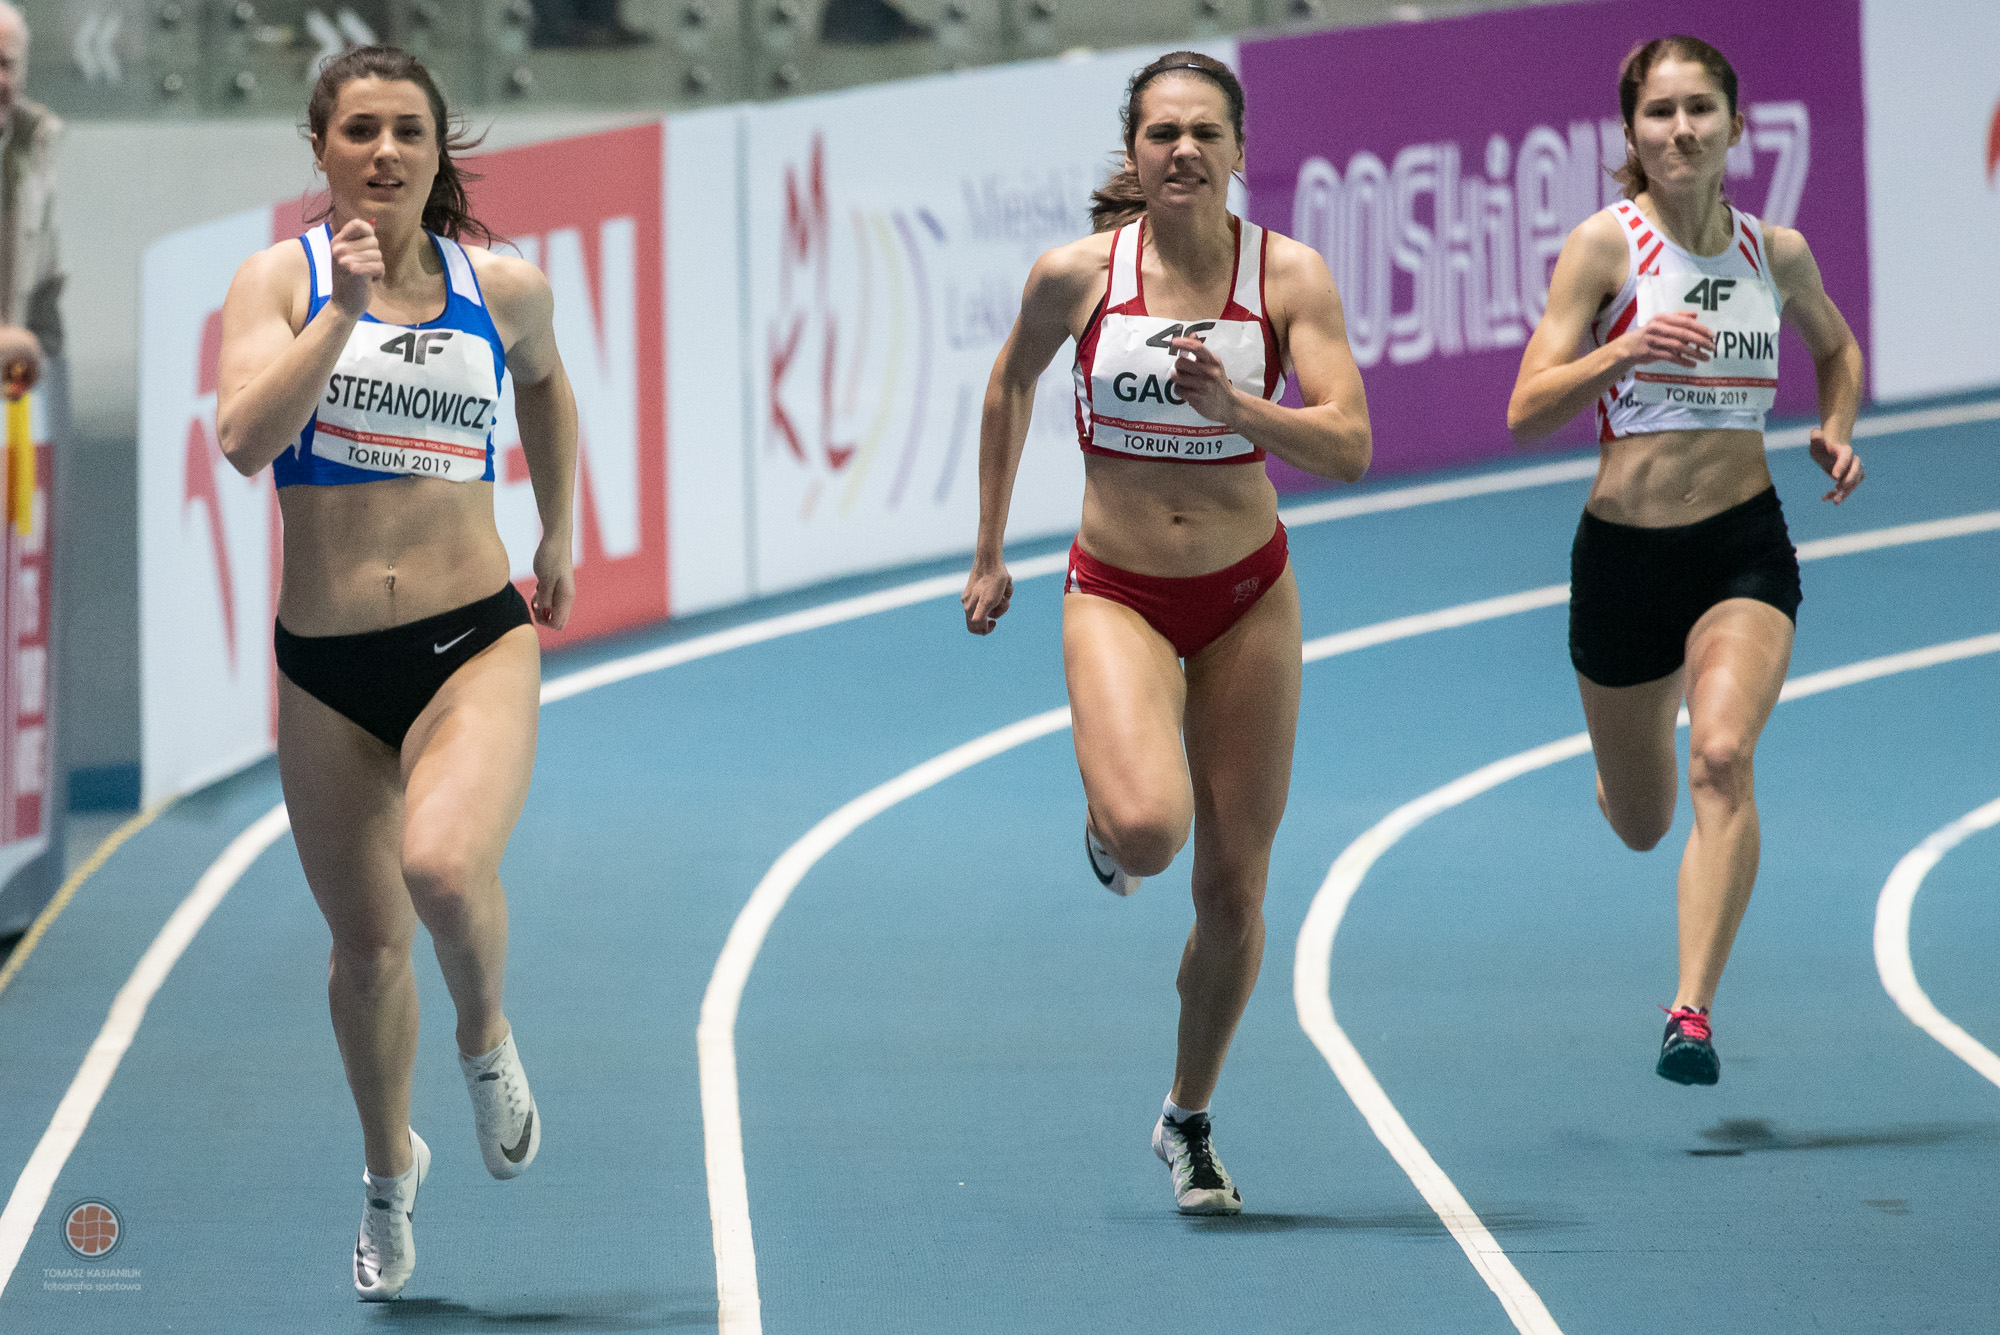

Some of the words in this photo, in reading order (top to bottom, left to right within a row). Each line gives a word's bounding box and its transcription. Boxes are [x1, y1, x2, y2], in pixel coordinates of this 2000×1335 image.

[1684, 278, 1736, 311] 4F
[380, 332, 453, 365] 4F
[1711, 331, 1774, 361] YPNIK
[326, 373, 491, 430] STEFANOWICZ
[1666, 386, 1717, 405] TORUŃ
[1720, 390, 1748, 405] 2019
[1146, 424, 1197, 434] MISTRZOSTWA
[1124, 434, 1179, 454] TORUŃ
[1185, 440, 1223, 455] 2019
[348, 446, 406, 468] TORUŃ
[411, 455, 451, 474] 2019
